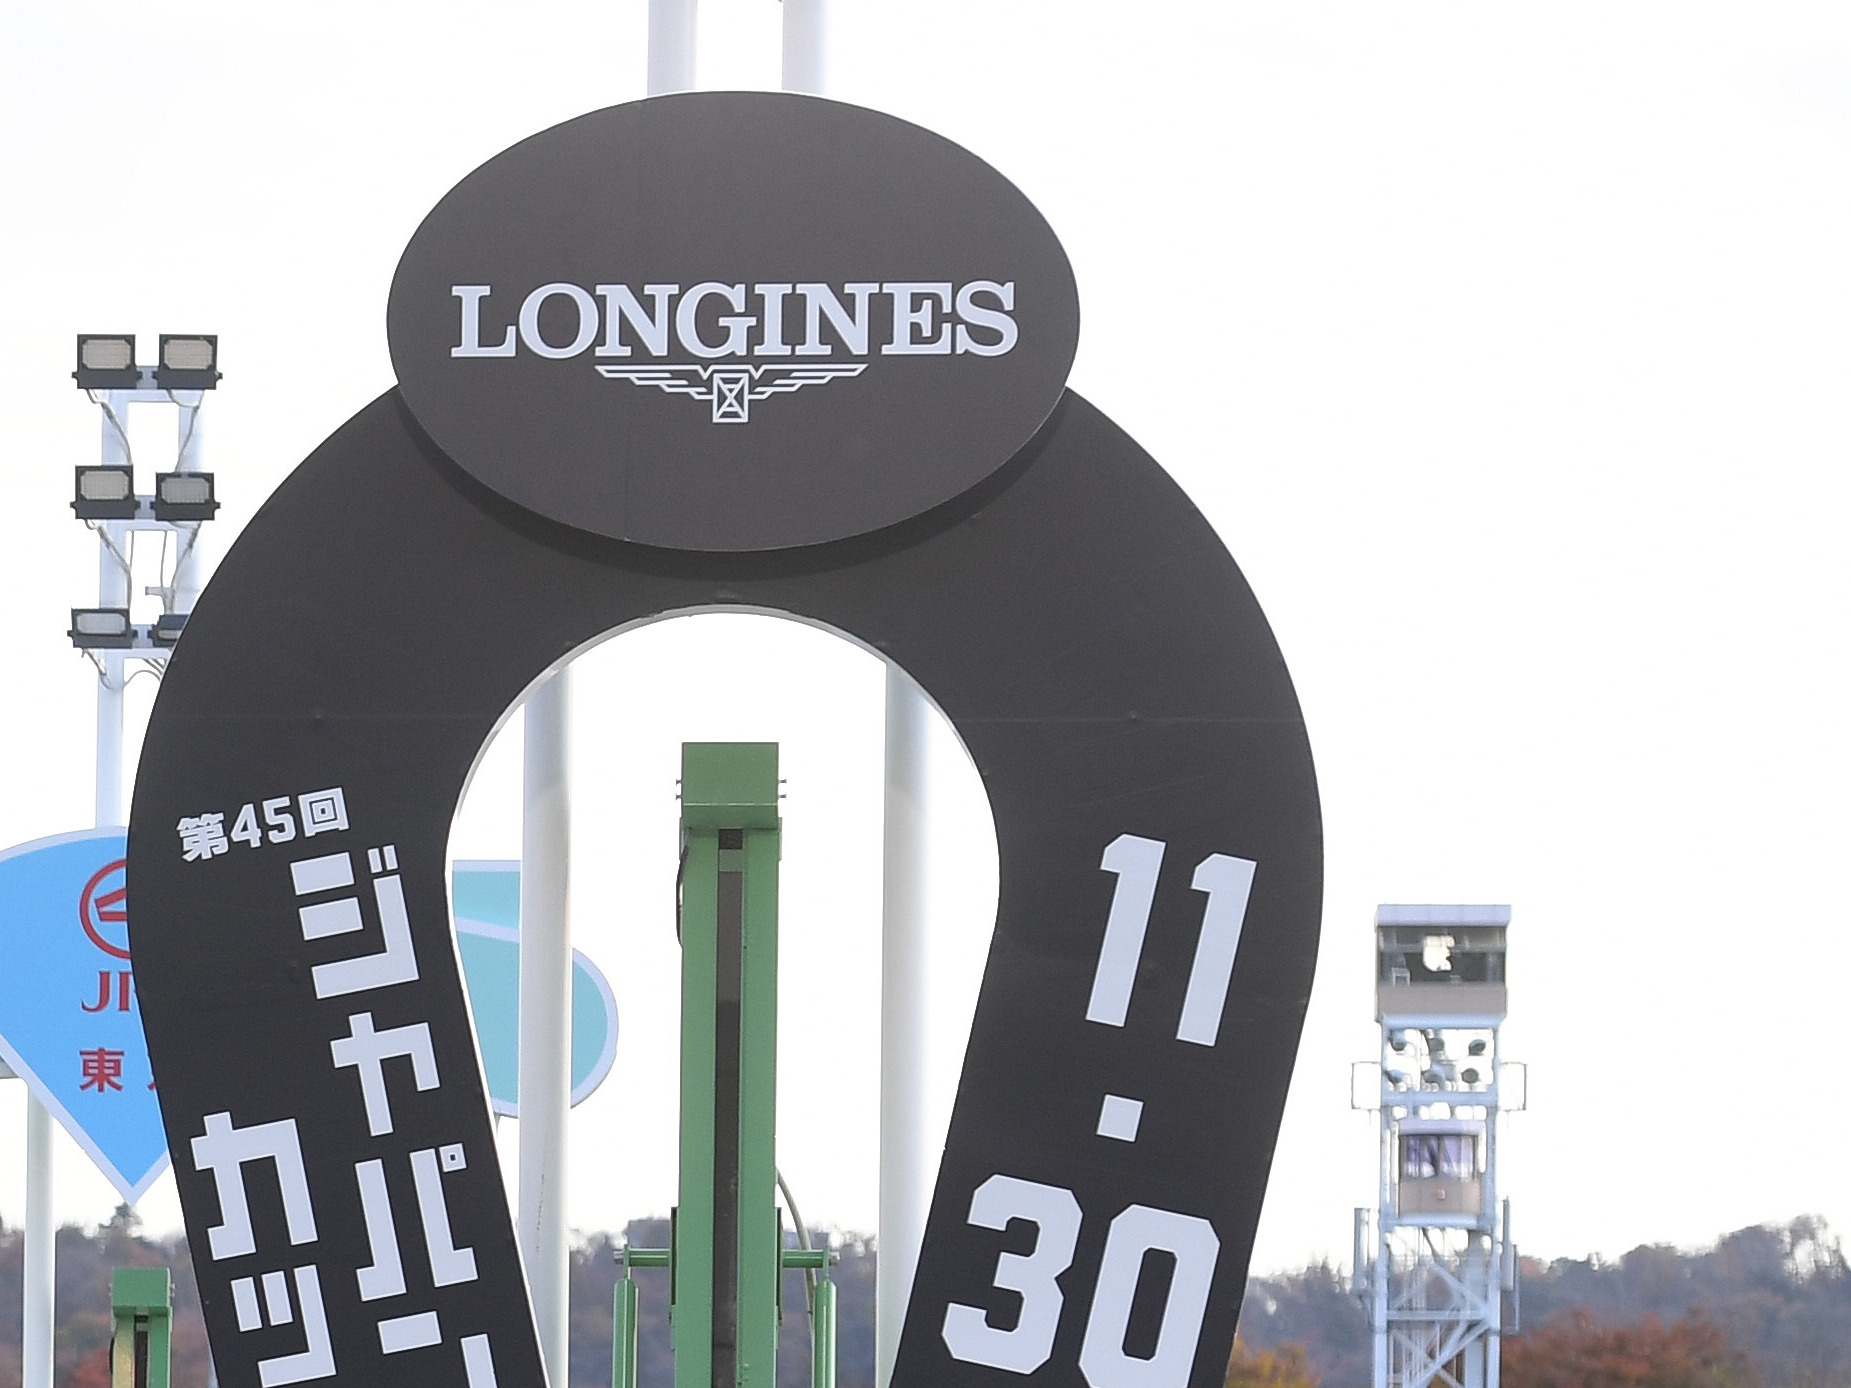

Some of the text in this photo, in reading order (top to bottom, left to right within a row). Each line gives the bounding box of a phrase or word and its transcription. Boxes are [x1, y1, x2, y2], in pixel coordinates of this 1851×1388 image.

[451, 281, 1020, 359] LONGINES
[176, 787, 349, 862] 第45回
[1085, 833, 1257, 1047] 11
